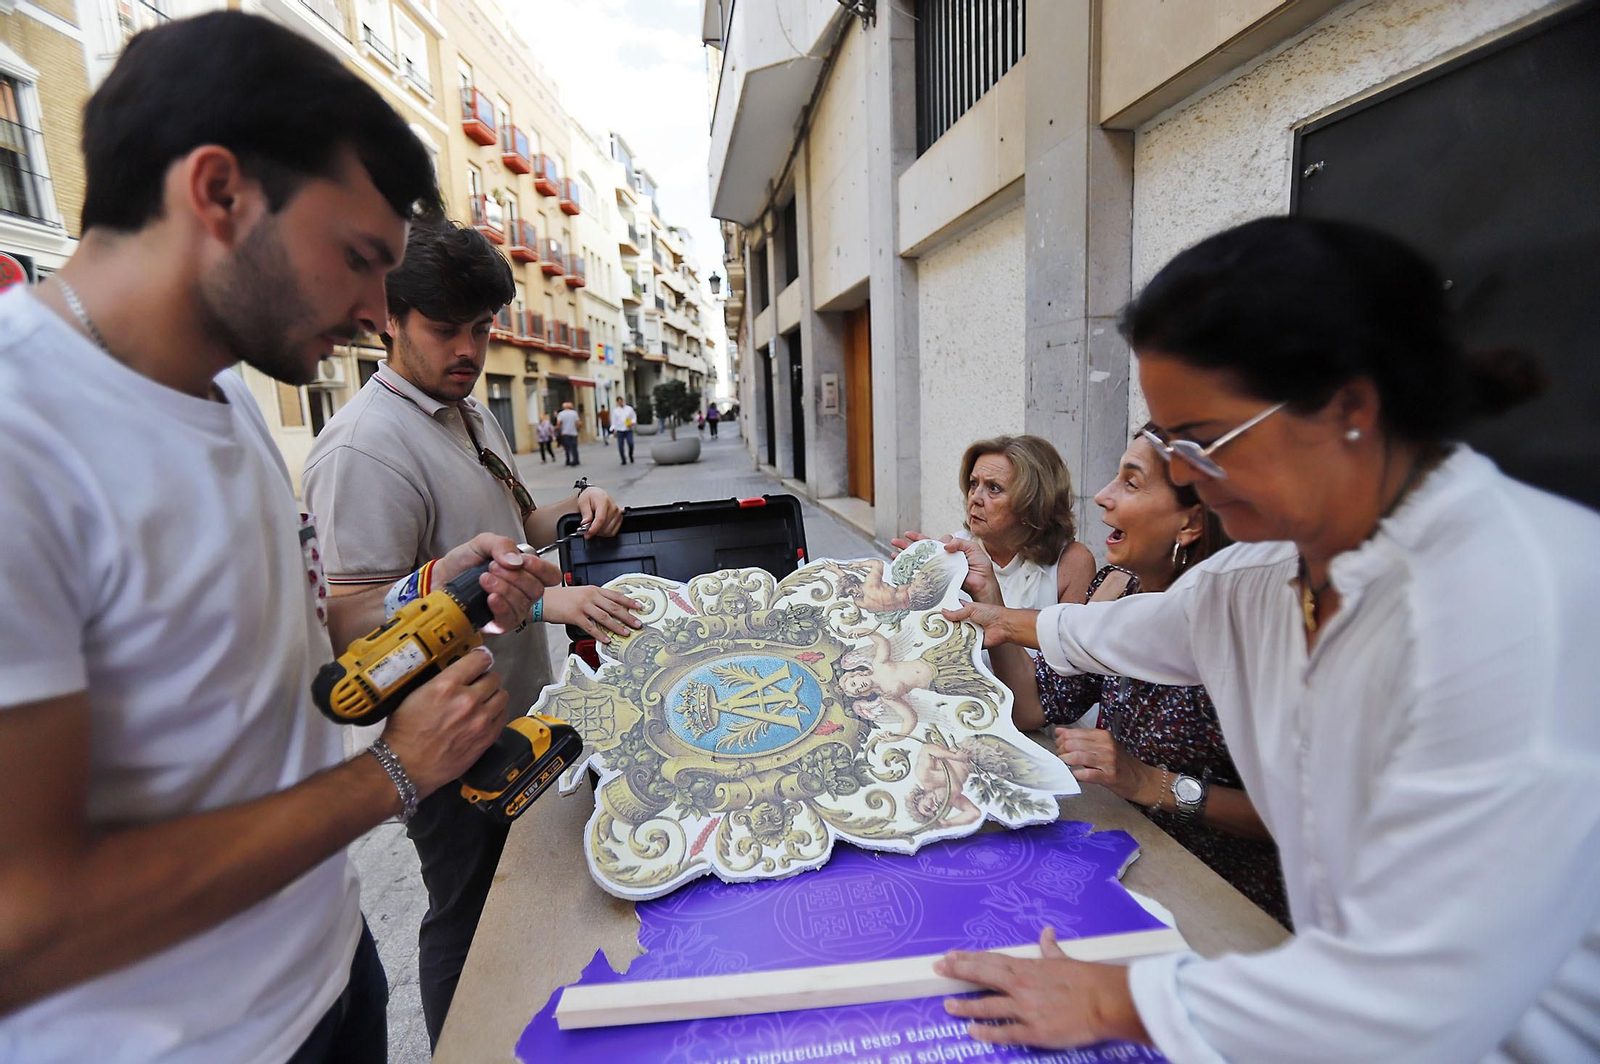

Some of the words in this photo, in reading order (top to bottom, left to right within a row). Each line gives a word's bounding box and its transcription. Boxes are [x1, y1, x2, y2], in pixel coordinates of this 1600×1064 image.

[524, 781, 539, 797] 18V
[860, 1032, 902, 1051] casa
[746, 1040, 857, 1064] hermandad
[915, 1041, 995, 1064] azulejos
[1102, 1044, 1139, 1062] año
